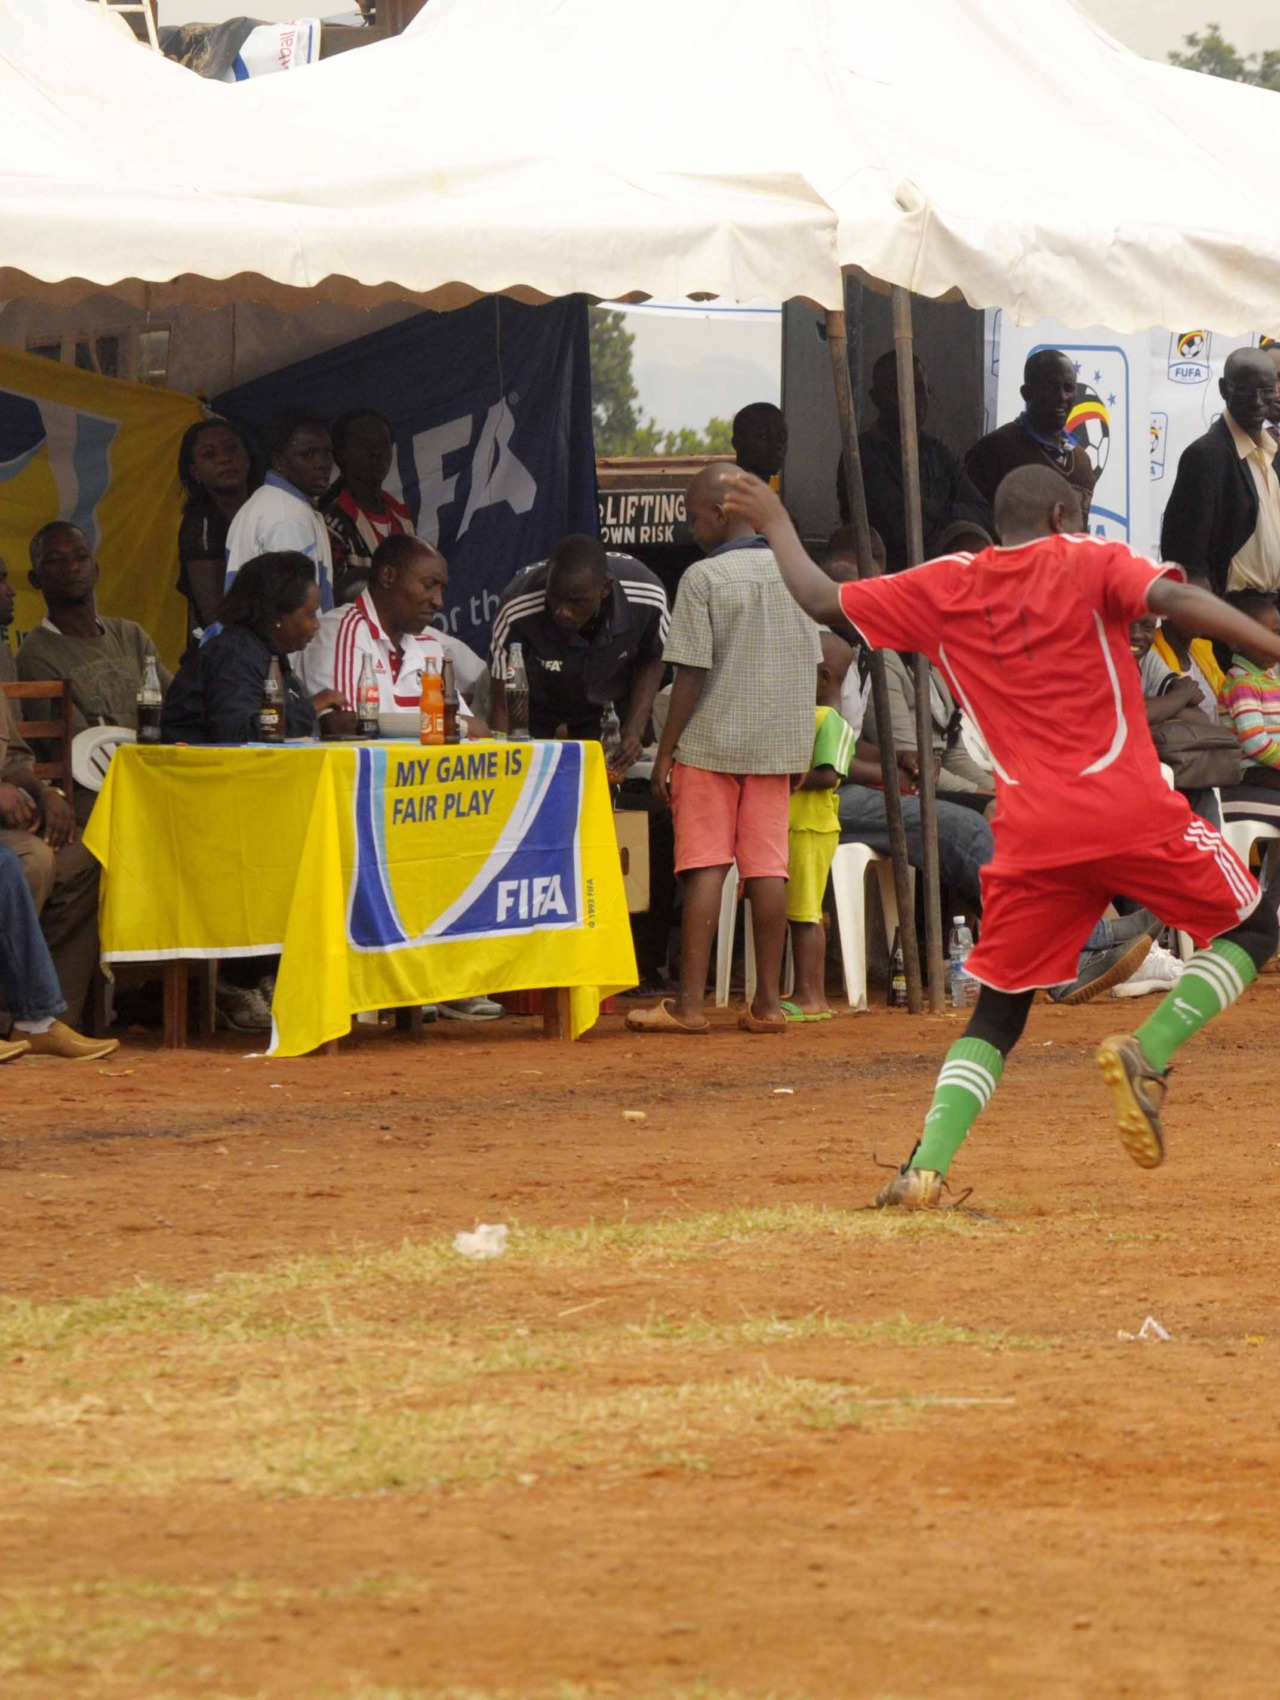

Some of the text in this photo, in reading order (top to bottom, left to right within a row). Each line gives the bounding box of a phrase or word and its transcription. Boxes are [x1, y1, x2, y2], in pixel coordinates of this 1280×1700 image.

[1175, 367, 1202, 378] FUFA
[639, 524, 675, 544] RISK
[394, 748, 523, 788] MY GAME IS
[392, 788, 496, 825] FAIR PLAY
[495, 874, 569, 923] FIFA
